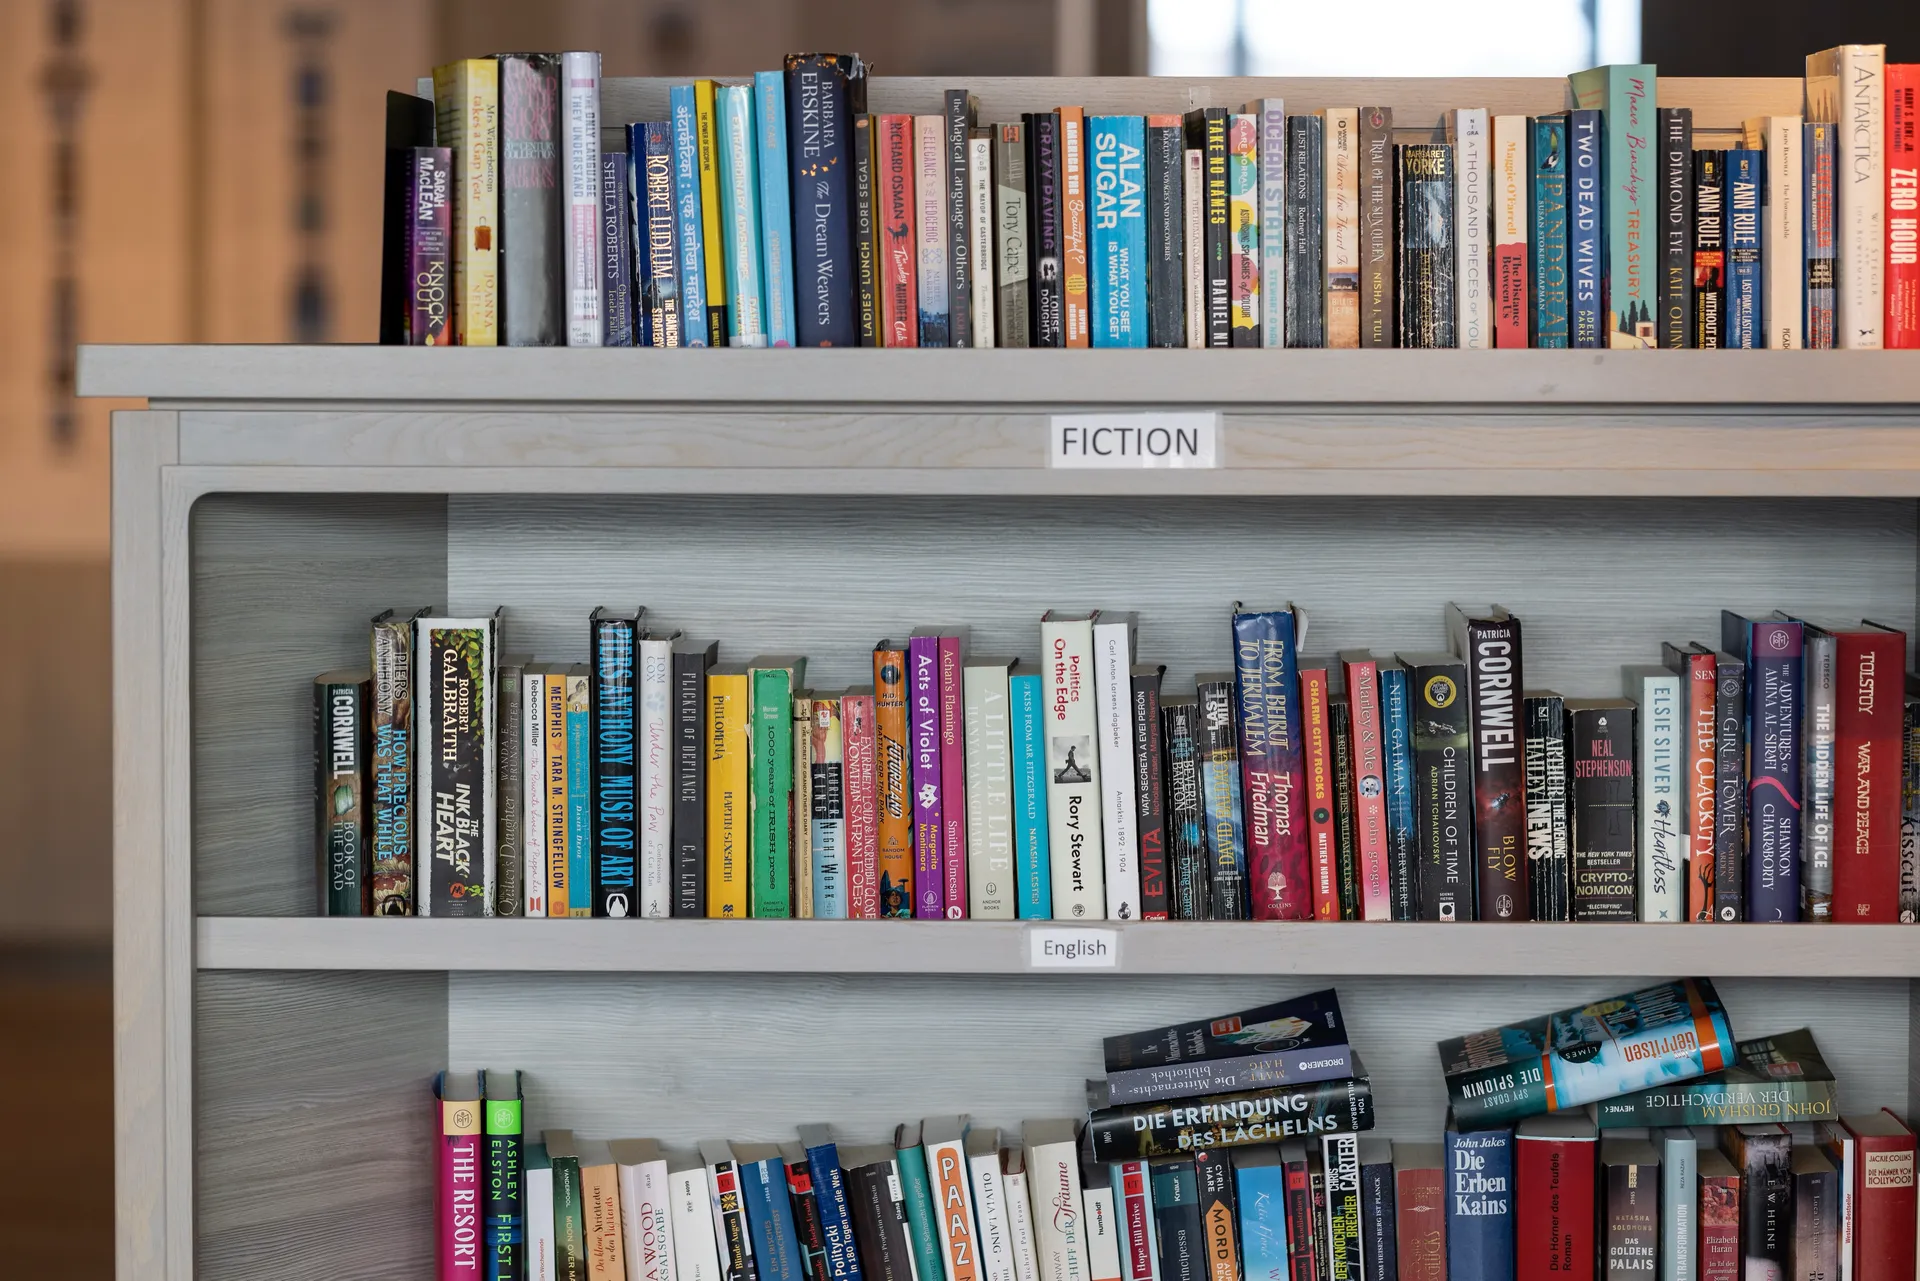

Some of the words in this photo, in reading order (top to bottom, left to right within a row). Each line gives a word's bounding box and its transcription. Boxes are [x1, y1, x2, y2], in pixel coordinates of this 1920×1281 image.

[473, 96, 483, 129] takes
[486, 104, 495, 123] Mrs
[801, 72, 819, 158] ERSKINE
[822, 81, 834, 148] BARBARA
[953, 99, 962, 113] the
[950, 115, 966, 162] Magical
[1297, 130, 1306, 149] JUST
[1853, 66, 1875, 184] ANTARCTICA
[470, 142, 485, 170] Gap
[485, 126, 495, 193] Winterbottom
[703, 146, 711, 171] DISCIPLINE
[1578, 121, 1593, 168] TWO
[434, 171, 445, 207] SARAH
[472, 174, 483, 200] Year
[816, 181, 829, 199] The
[1095, 133, 1116, 229] SUGAR
[1119, 143, 1140, 218] ALAN
[1298, 151, 1307, 199] RELATIONS
[1890, 168, 1916, 210] ZERO
[680, 192, 696, 217] एक
[951, 168, 966, 229] Language
[1003, 198, 1022, 230] Tony
[1578, 178, 1593, 231] DEAD
[815, 204, 831, 257] Dream
[956, 233, 965, 242] of
[1296, 207, 1307, 235] Rodney
[681, 223, 699, 270] अनोखा
[1006, 237, 1021, 274] Cape
[1108, 241, 1117, 252] IS
[1298, 238, 1307, 254] Hall
[1890, 219, 1917, 264] HOUR
[956, 245, 966, 289] Others
[1108, 255, 1118, 287] WHAT
[1119, 248, 1129, 280] WHAT
[1578, 239, 1593, 301] WIVES
[417, 272, 431, 312] OUT
[430, 261, 444, 328] KNOCK
[685, 276, 702, 321] महादेश
[817, 260, 833, 325] Weavers
[1109, 290, 1118, 314] YOU
[1120, 283, 1129, 308] YOU
[1110, 317, 1119, 339] GET
[1120, 310, 1130, 332] SEE
[1586, 310, 1594, 342] ADELE
[1063, 428, 1197, 455] FICTION
[1054, 638, 1065, 659] On
[1478, 629, 1511, 639] PATRICIA
[918, 654, 932, 692] Acts
[1055, 662, 1065, 684] the
[1068, 655, 1081, 702] Politics
[1859, 652, 1874, 715] TOLSTOY
[443, 649, 456, 761] GALBRAITH
[459, 678, 468, 732] ROBERT
[550, 686, 562, 738] MEMPHIS
[920, 696, 935, 713] of
[944, 694, 956, 745] Flamingo
[1054, 688, 1067, 720] Edge
[1479, 641, 1514, 771] CORNWELL
[1654, 688, 1671, 732] ELSIE
[1816, 704, 1829, 730] THE
[333, 695, 354, 779] CORNWELL
[377, 724, 391, 757] WAS
[768, 725, 776, 756] 1000
[919, 719, 935, 769] Violet
[1698, 706, 1714, 752] THE
[393, 730, 406, 766] HOW
[1815, 735, 1829, 787] HIDDEN
[1857, 741, 1870, 776] WAR
[378, 762, 392, 802] THAT
[552, 755, 562, 782] TARA
[767, 759, 776, 793] years
[1443, 747, 1457, 819] CHILDREN
[1654, 738, 1671, 794] SILVER
[552, 787, 562, 800] M.
[768, 795, 777, 808] of
[1251, 771, 1270, 845] Friedman
[1273, 771, 1292, 836] Thomas
[1696, 758, 1715, 857] CLACKITY
[1815, 792, 1829, 819] LIFE
[1857, 778, 1870, 809] AND
[394, 773, 407, 855] PRECIOUS
[1067, 796, 1082, 829] Rory
[333, 820, 343, 848] THE
[343, 822, 354, 866] BOOK
[378, 808, 392, 860] WHILE
[552, 804, 563, 889] STRINGFELLOW
[919, 823, 927, 871] Montimore
[929, 824, 939, 870] Margarita
[948, 820, 958, 856] Smitha
[1431, 803, 1440, 865] TCHAIKOVSKY
[1446, 826, 1458, 846] OF
[1815, 824, 1829, 843] OF
[1857, 812, 1869, 854] PEACE
[334, 852, 344, 890] DEAD
[768, 856, 776, 890] prose
[1071, 834, 1083, 892] Stewart
[1446, 850, 1459, 884] TIME
[1488, 847, 1500, 871] FLY
[1502, 835, 1516, 881] BLOW
[1651, 819, 1676, 894] Heartless
[1815, 846, 1828, 868] ICE
[344, 870, 354, 888] OF
[949, 859, 958, 901] Umesan
[1045, 940, 1106, 959] English
[1307, 1060, 1344, 1070] DROEMER
[1520, 1067, 1541, 1083] DIE
[1461, 1073, 1514, 1099] SPIONIN
[1134, 1115, 1166, 1132] DIE
[1172, 1094, 1308, 1127] ERFINDUNG
[1178, 1132, 1215, 1148] DES
[1222, 1114, 1338, 1141] LÄCHELNS
[1454, 1139, 1478, 1149] John
[1480, 1138, 1505, 1147] Jakes
[453, 1143, 474, 1183] THE
[492, 1140, 501, 1200] ELSTON
[507, 1140, 516, 1200] ASHLEY
[1455, 1150, 1485, 1170] Die
[1878, 1168, 1899, 1176] MÄNNER
[983, 1173, 995, 1214] OLIVIA
[1206, 1167, 1214, 1192] HARE
[1215, 1164, 1224, 1192] CYRIL
[1455, 1173, 1506, 1193] Erben
[1869, 1176, 1911, 1185] HOLLYWOOD
[1132, 1204, 1142, 1227] Drive
[1455, 1195, 1507, 1216] Kains
[454, 1189, 475, 1269] RESORT
[498, 1214, 511, 1265] FIRST
[988, 1218, 1001, 1254] LAING
[1134, 1230, 1142, 1246] Hill
[1213, 1209, 1228, 1260] MORD
[1707, 1236, 1738, 1244] Elizabeth
[1137, 1248, 1148, 1271] Hope
[1610, 1248, 1653, 1256] GOLDENE
[1610, 1259, 1654, 1270] PALAIS
[1711, 1245, 1732, 1253] Haran
